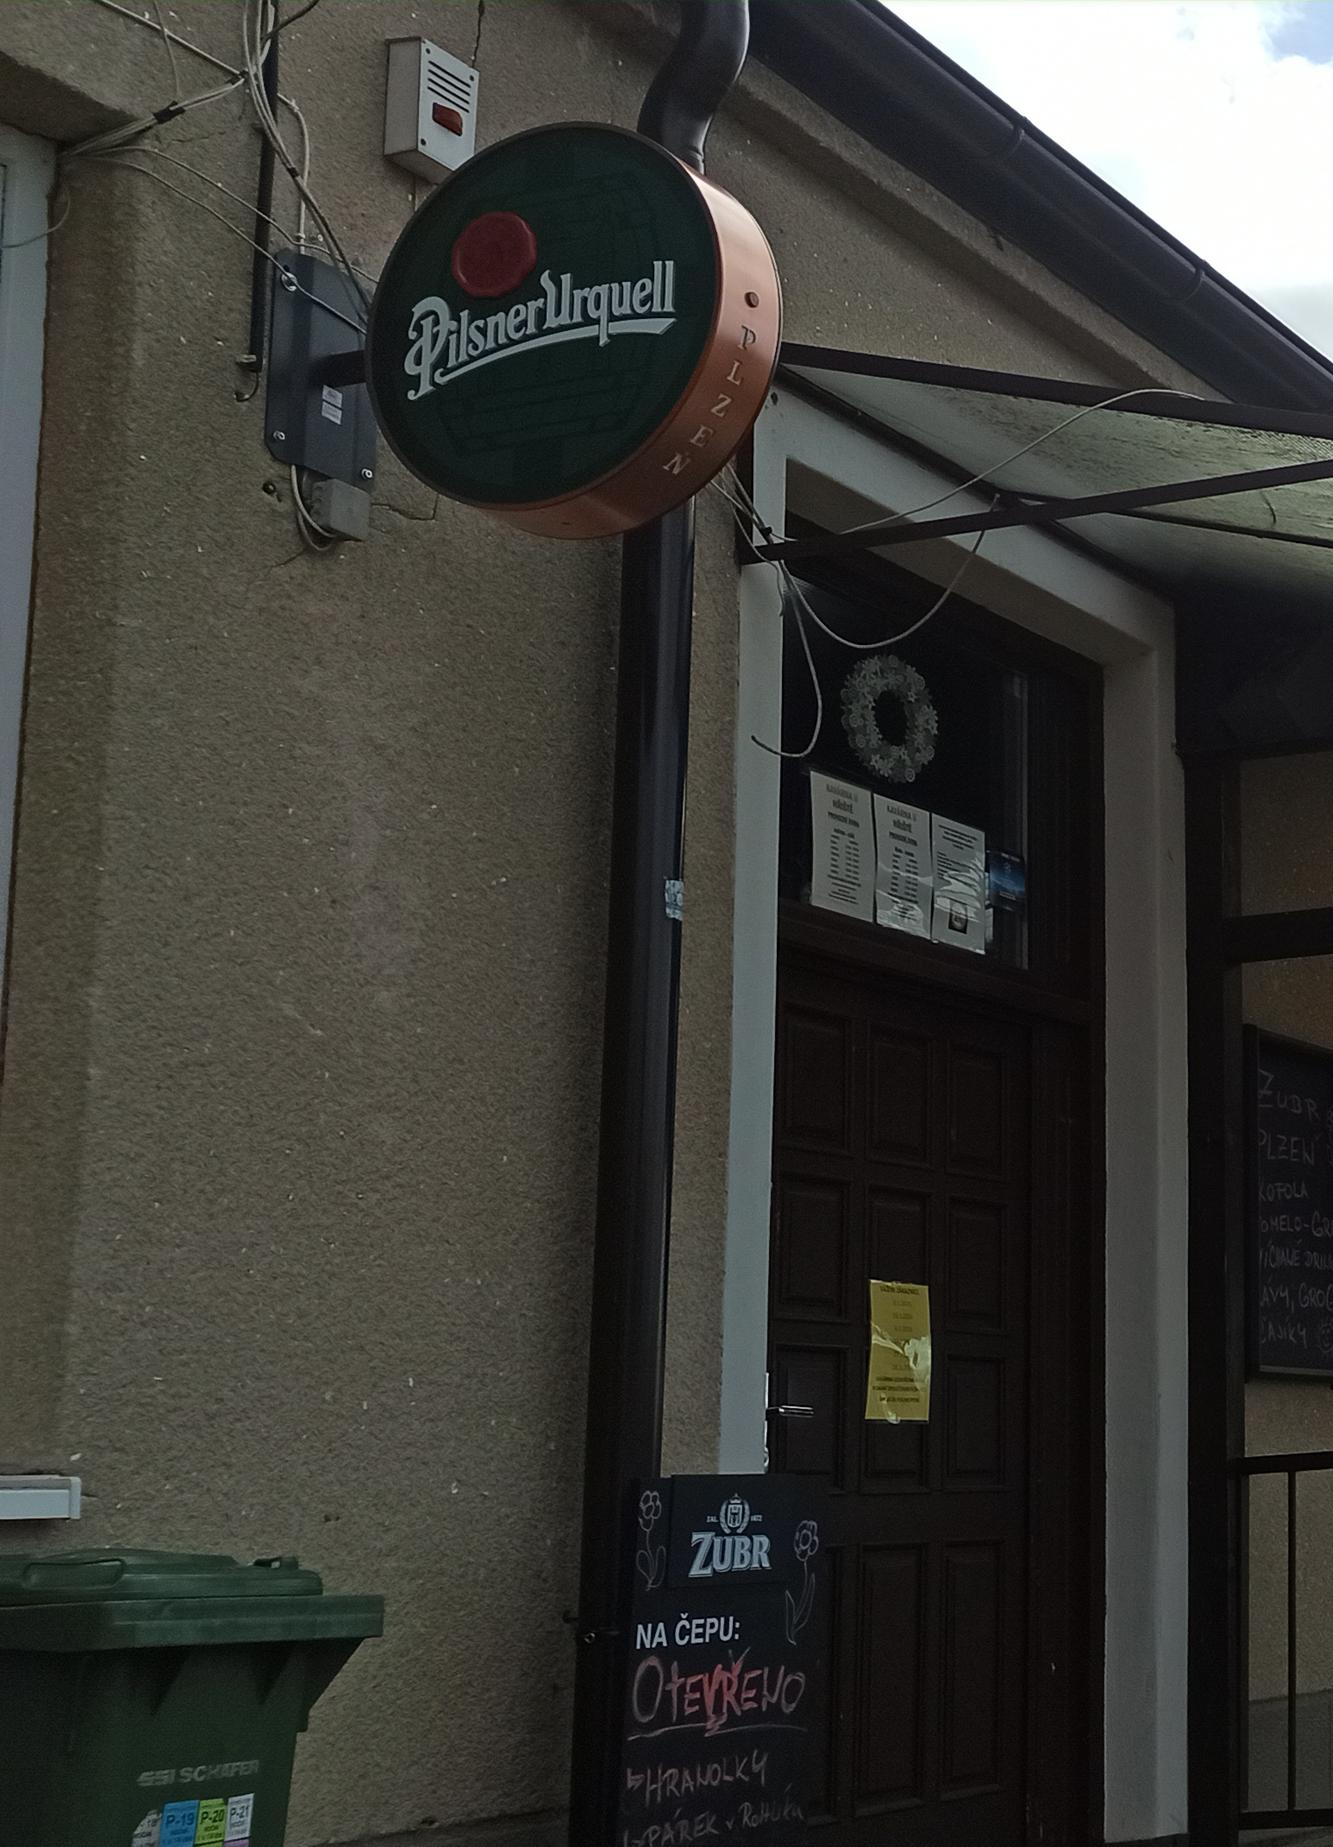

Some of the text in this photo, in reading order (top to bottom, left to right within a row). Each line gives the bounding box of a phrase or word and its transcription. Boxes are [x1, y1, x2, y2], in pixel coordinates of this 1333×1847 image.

[403, 260, 677, 401] Pilsner Urquell
[688, 1531, 773, 1578] ZUBR
[636, 1612, 741, 1650] NA ČEPU:
[200, 1809, 225, 1823] P-20
